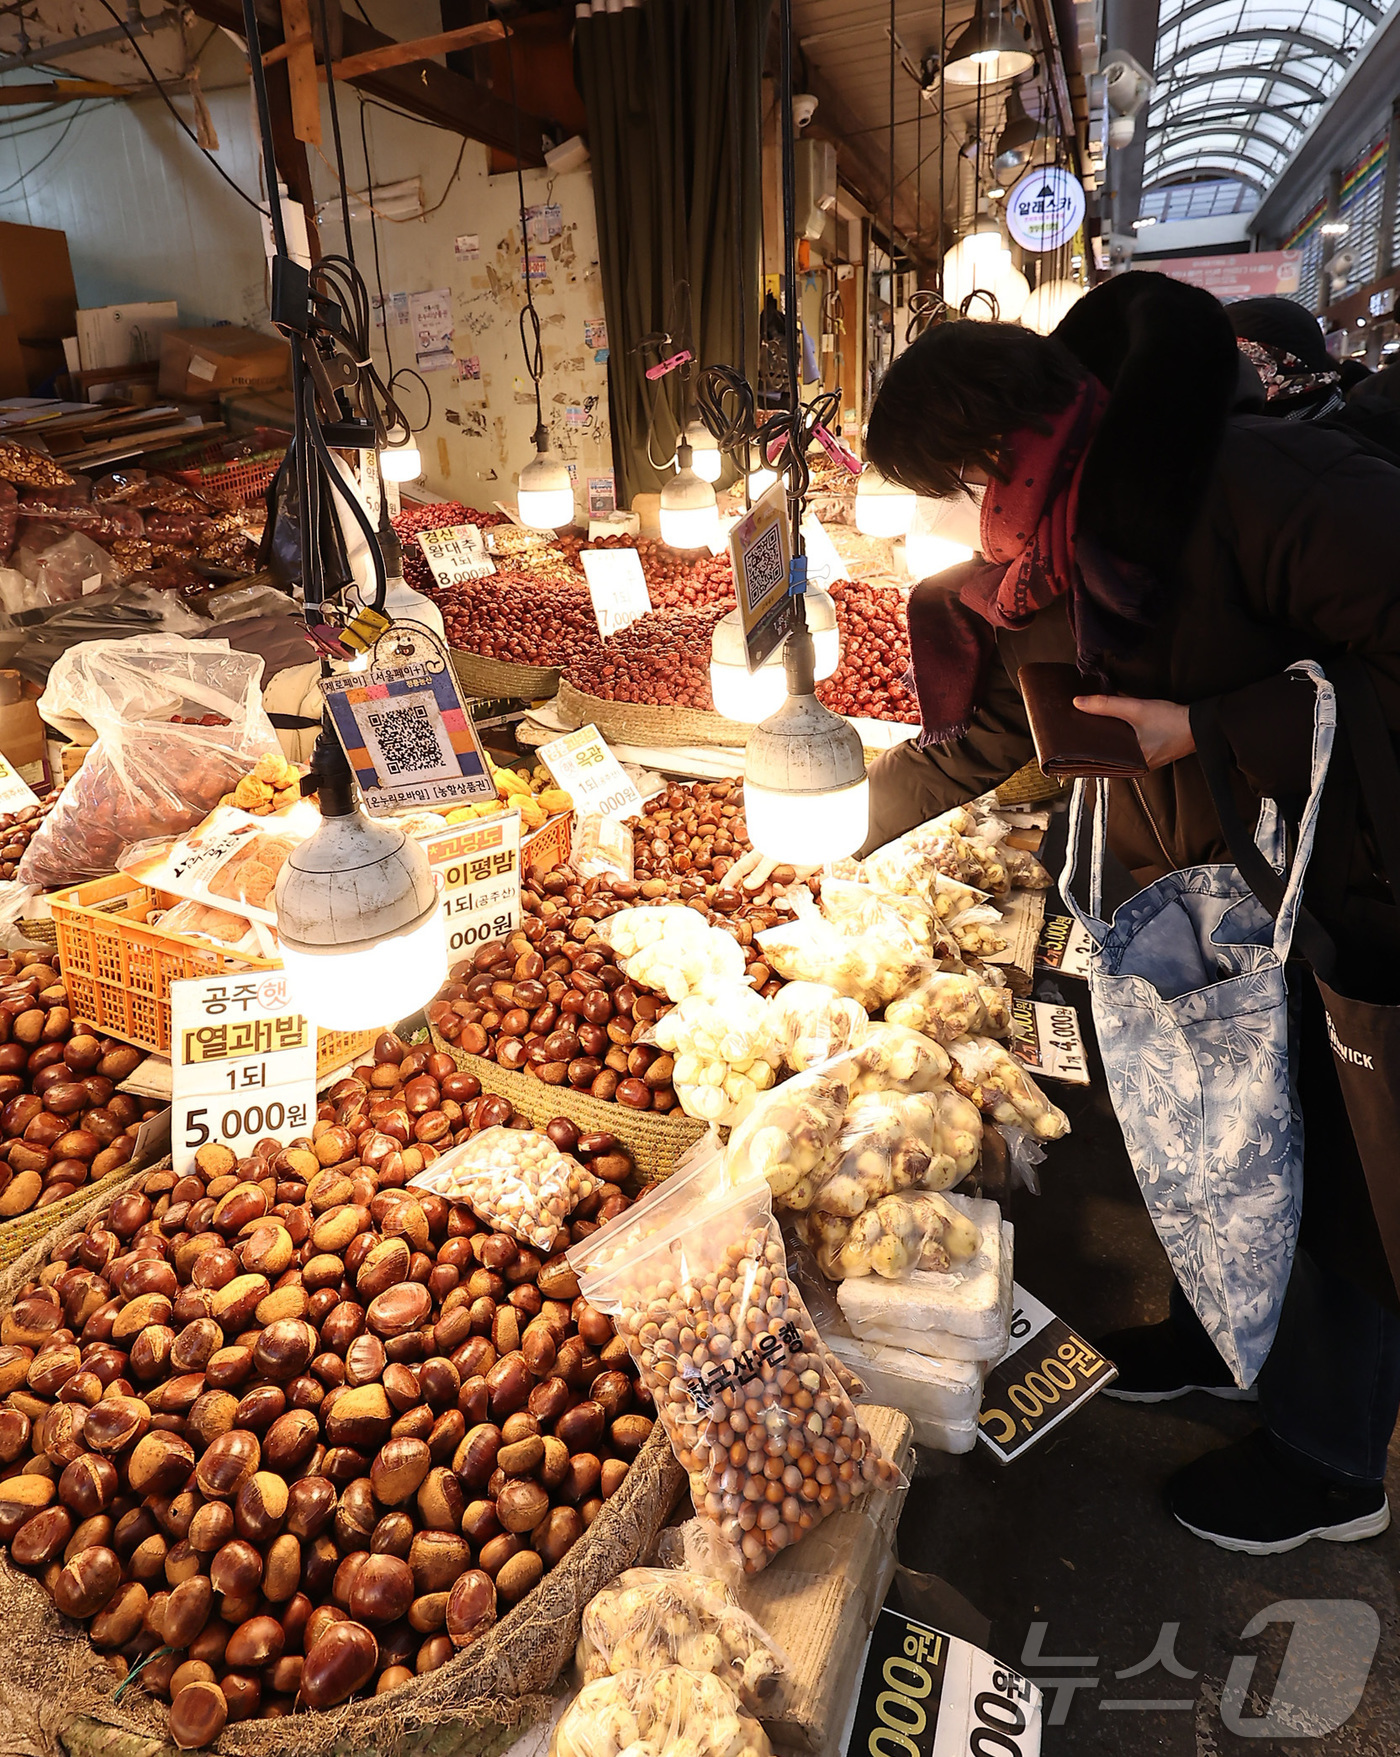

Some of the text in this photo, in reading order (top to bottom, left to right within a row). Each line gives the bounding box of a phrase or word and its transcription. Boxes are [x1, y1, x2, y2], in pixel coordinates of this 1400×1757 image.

[423, 529, 455, 543] 경산
[428, 539, 477, 559] 왕대추
[450, 555, 472, 567] 1되
[319, 664, 428, 695] [제로페이] [서울페이+]
[575, 744, 605, 768] 옥광
[366, 778, 491, 809] [온누리모바일] [농할상품권]
[578, 775, 598, 794] 1되
[446, 850, 516, 886] 이평밤
[443, 886, 517, 917] 1되 (공주산)
[201, 979, 288, 1015] 공주 햇
[185, 1014, 308, 1065] [열과]밤
[1049, 1006, 1082, 1073] 1개 4,000원
[226, 1062, 267, 1091] 1되
[185, 1102, 308, 1149] 5,000원
[979, 1335, 1105, 1444] 5,000원
